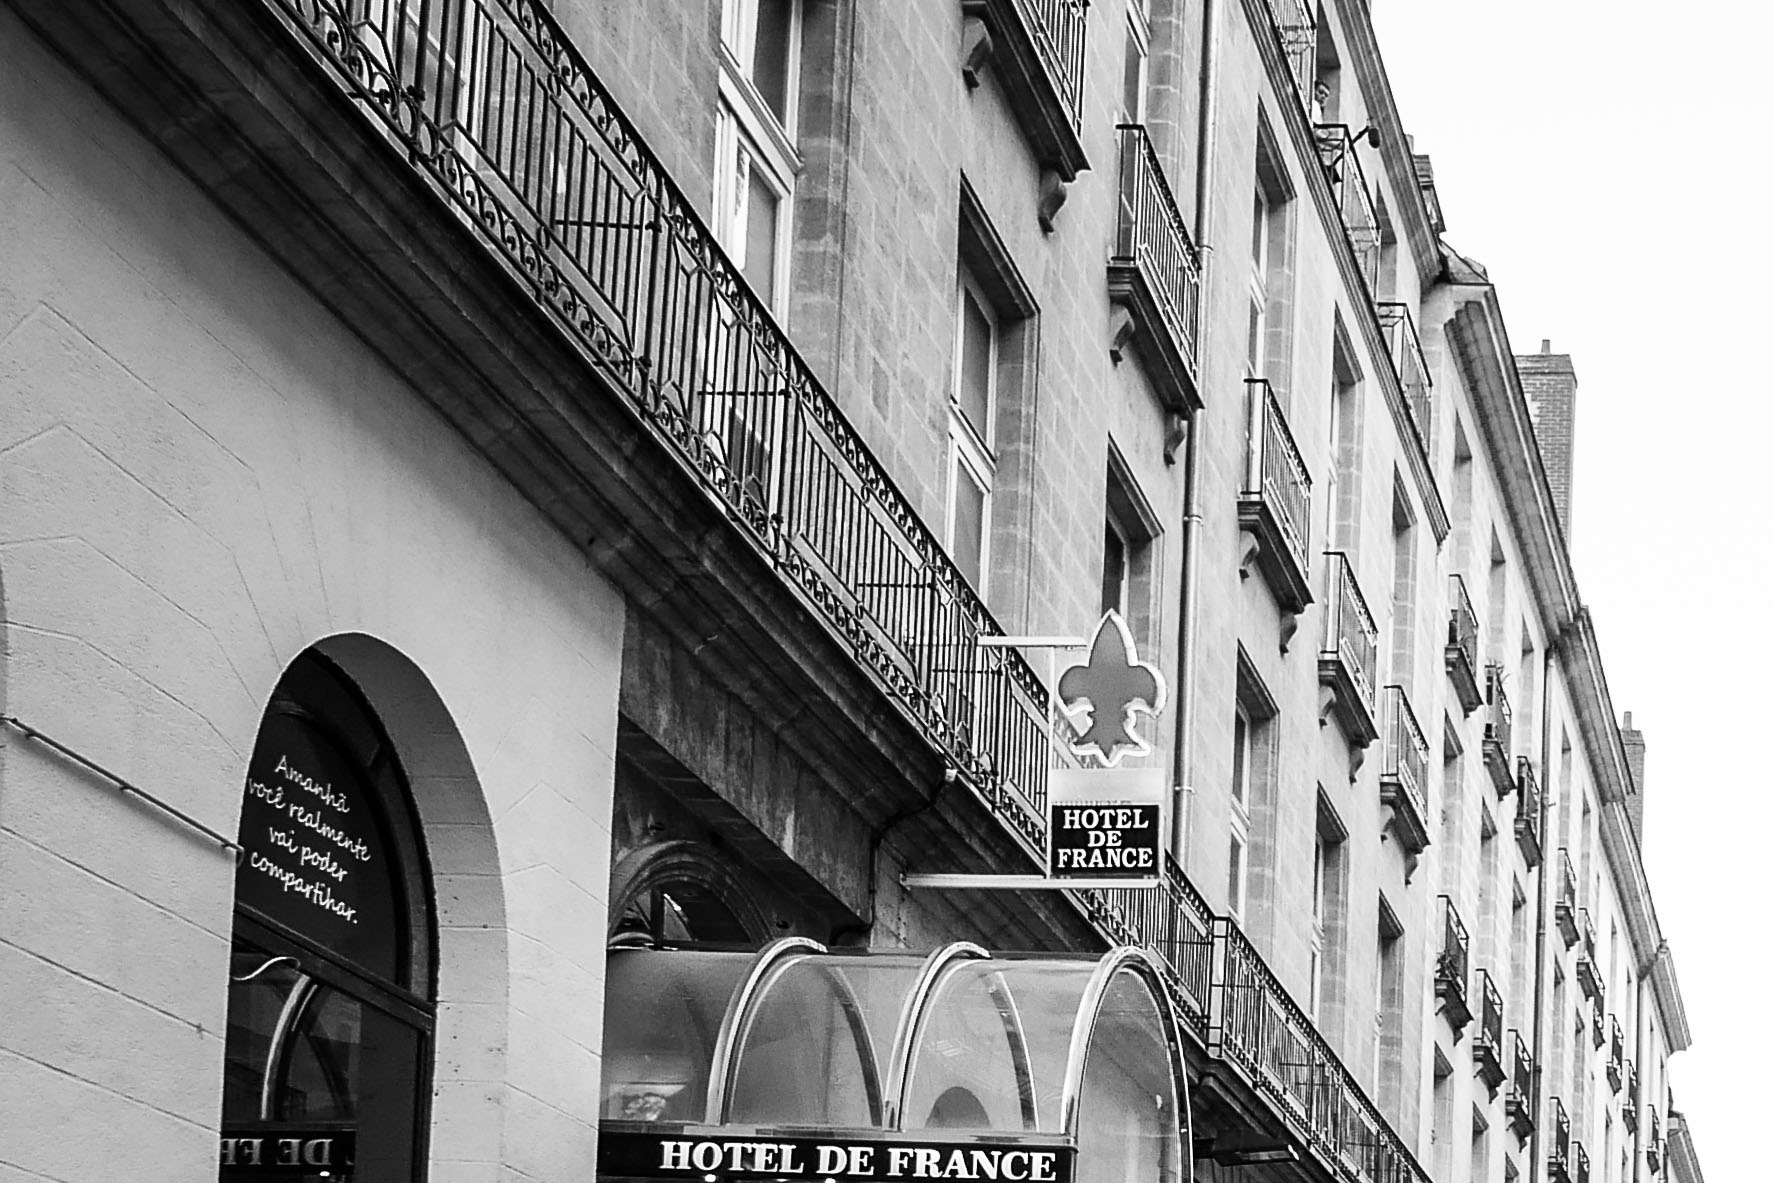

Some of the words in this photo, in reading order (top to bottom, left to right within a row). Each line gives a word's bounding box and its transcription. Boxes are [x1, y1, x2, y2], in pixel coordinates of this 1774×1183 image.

[275, 755, 349, 813] Amanhã
[249, 778, 285, 808] você
[290, 803, 370, 861] realmente
[1063, 809, 1149, 829] HOTEL
[1088, 830, 1122, 847] DE
[270, 826, 298, 853] vai
[301, 845, 348, 882] poder
[1057, 848, 1152, 868] FRANCE
[658, 1140, 803, 1172] HOTEL
[816, 1145, 875, 1175] DE
[888, 1147, 1057, 1183] FRANCE
